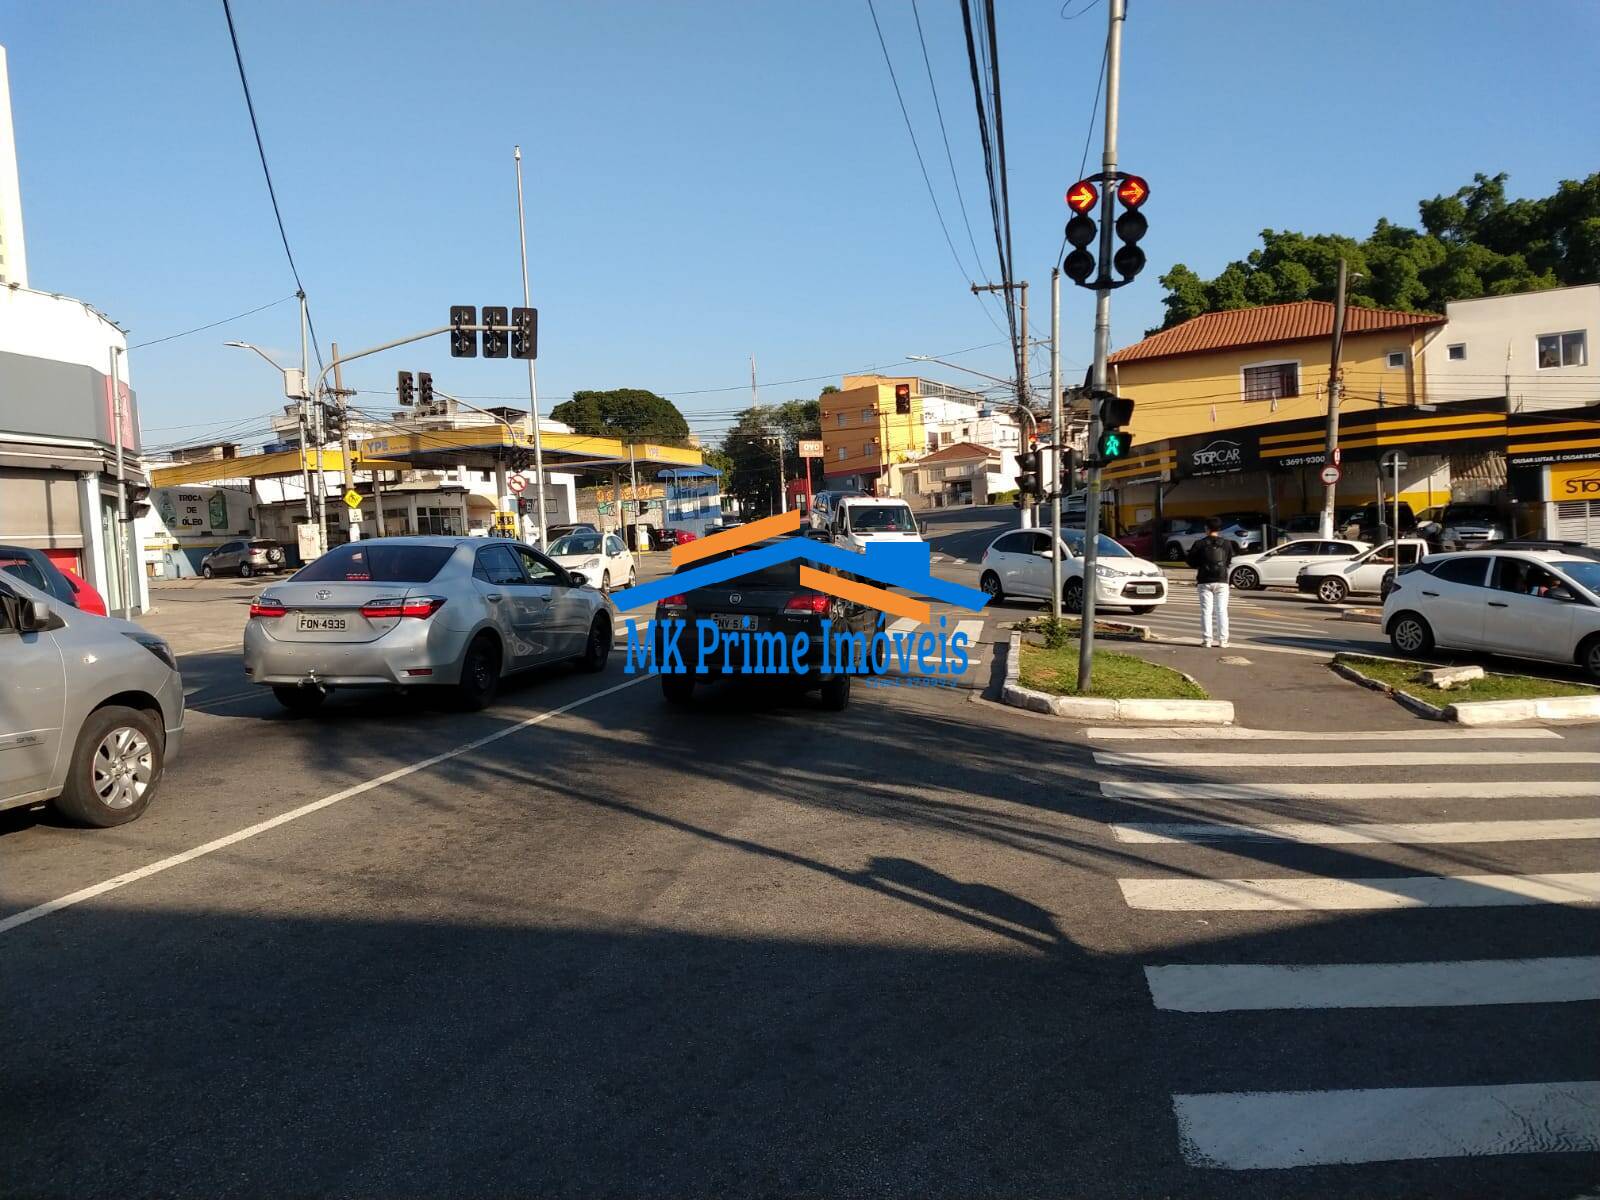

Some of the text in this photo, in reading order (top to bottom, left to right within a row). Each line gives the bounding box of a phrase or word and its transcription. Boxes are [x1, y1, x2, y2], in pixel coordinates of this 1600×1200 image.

[179, 494, 204, 502] TROCA
[186, 506, 198, 514] DE
[182, 515, 203, 526] ÓLEO
